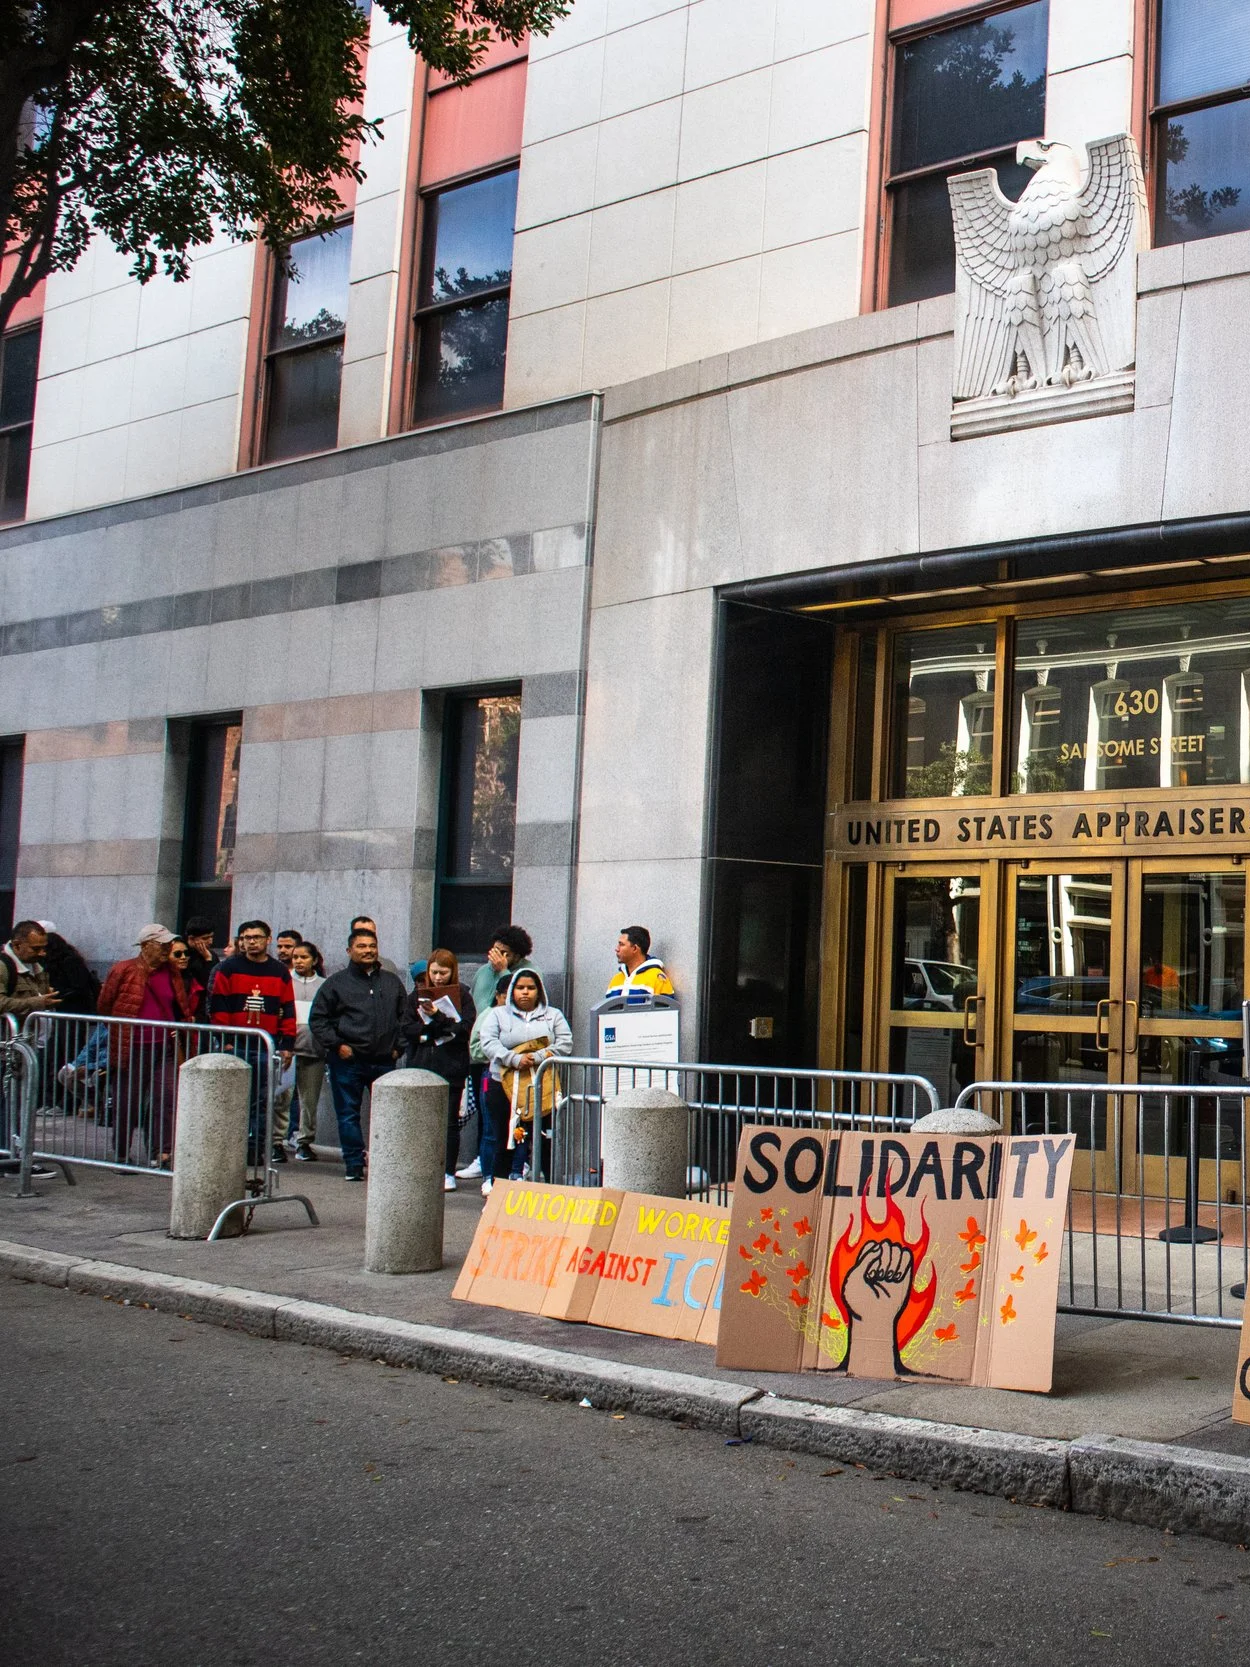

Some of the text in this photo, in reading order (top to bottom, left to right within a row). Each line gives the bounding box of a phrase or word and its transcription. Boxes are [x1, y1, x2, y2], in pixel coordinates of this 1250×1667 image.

[1114, 689, 1159, 717] 630
[848, 818, 940, 845] UNITED
[957, 813, 1053, 842] STATES
[604, 1034, 616, 1042] GSA
[743, 1131, 1074, 1201] SOLIDARITY
[505, 1189, 618, 1227] UNIONIZED
[469, 1225, 573, 1289] STRIKE
[566, 1246, 658, 1287] AGAINST
